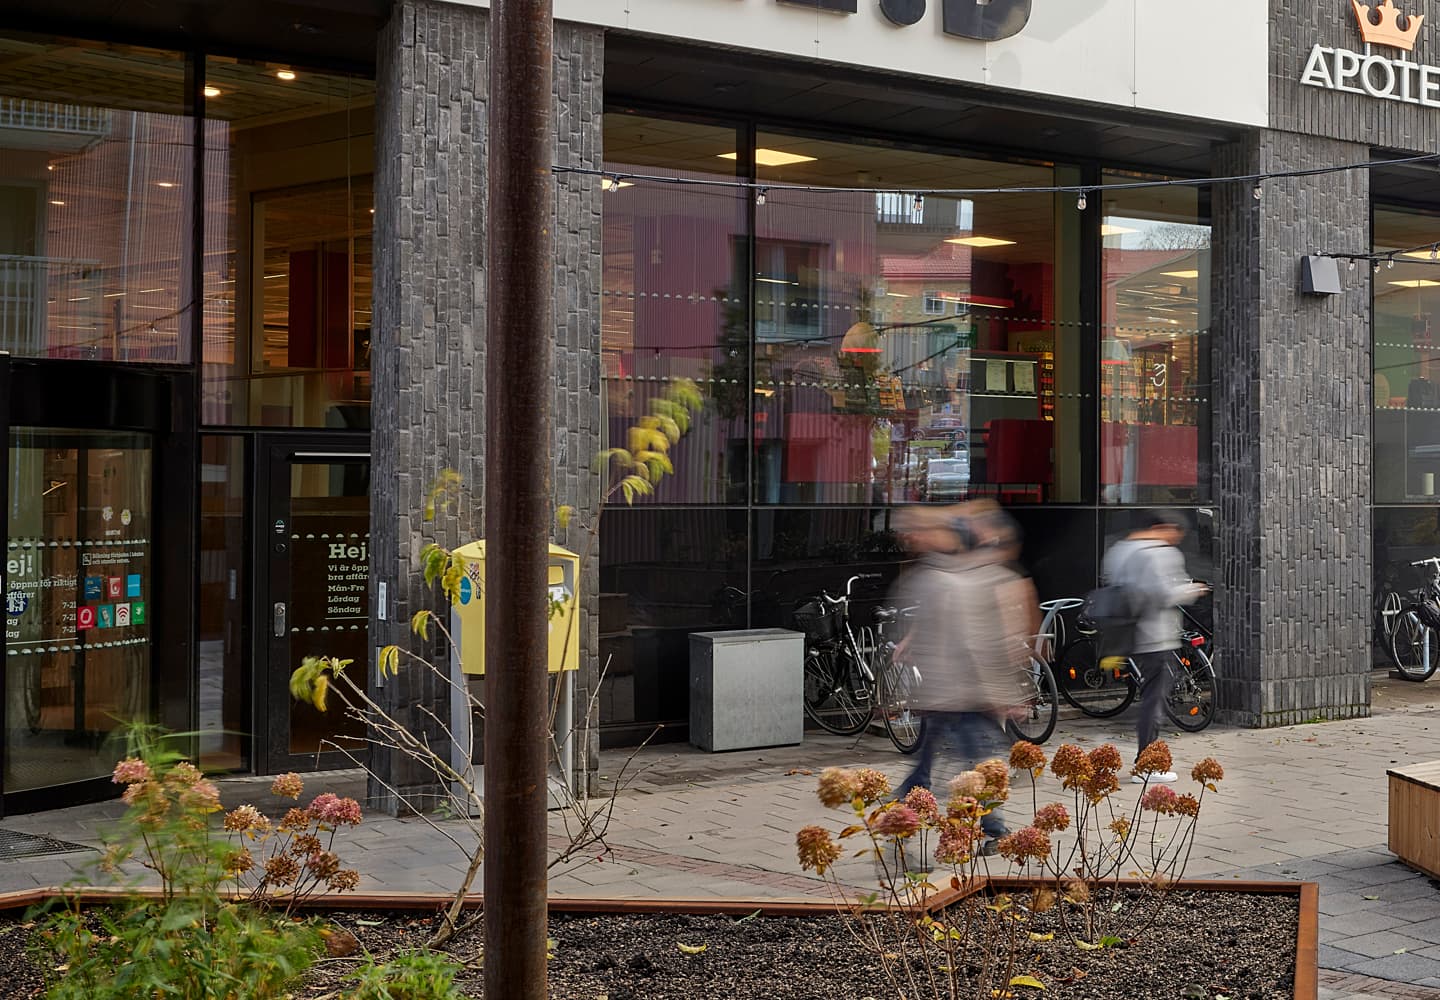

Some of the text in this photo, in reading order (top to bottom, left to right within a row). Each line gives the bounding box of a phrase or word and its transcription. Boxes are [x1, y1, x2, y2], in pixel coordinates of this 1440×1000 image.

[7, 554, 33, 576] ej!
[351, 564, 369, 573] öpp
[11, 580, 38, 590] öppna
[40, 578, 52, 588] för
[328, 595, 360, 603] Lördag
[62, 601, 77, 609] 7-21
[328, 606, 361, 614] Söndag
[62, 626, 77, 634] 7-21
